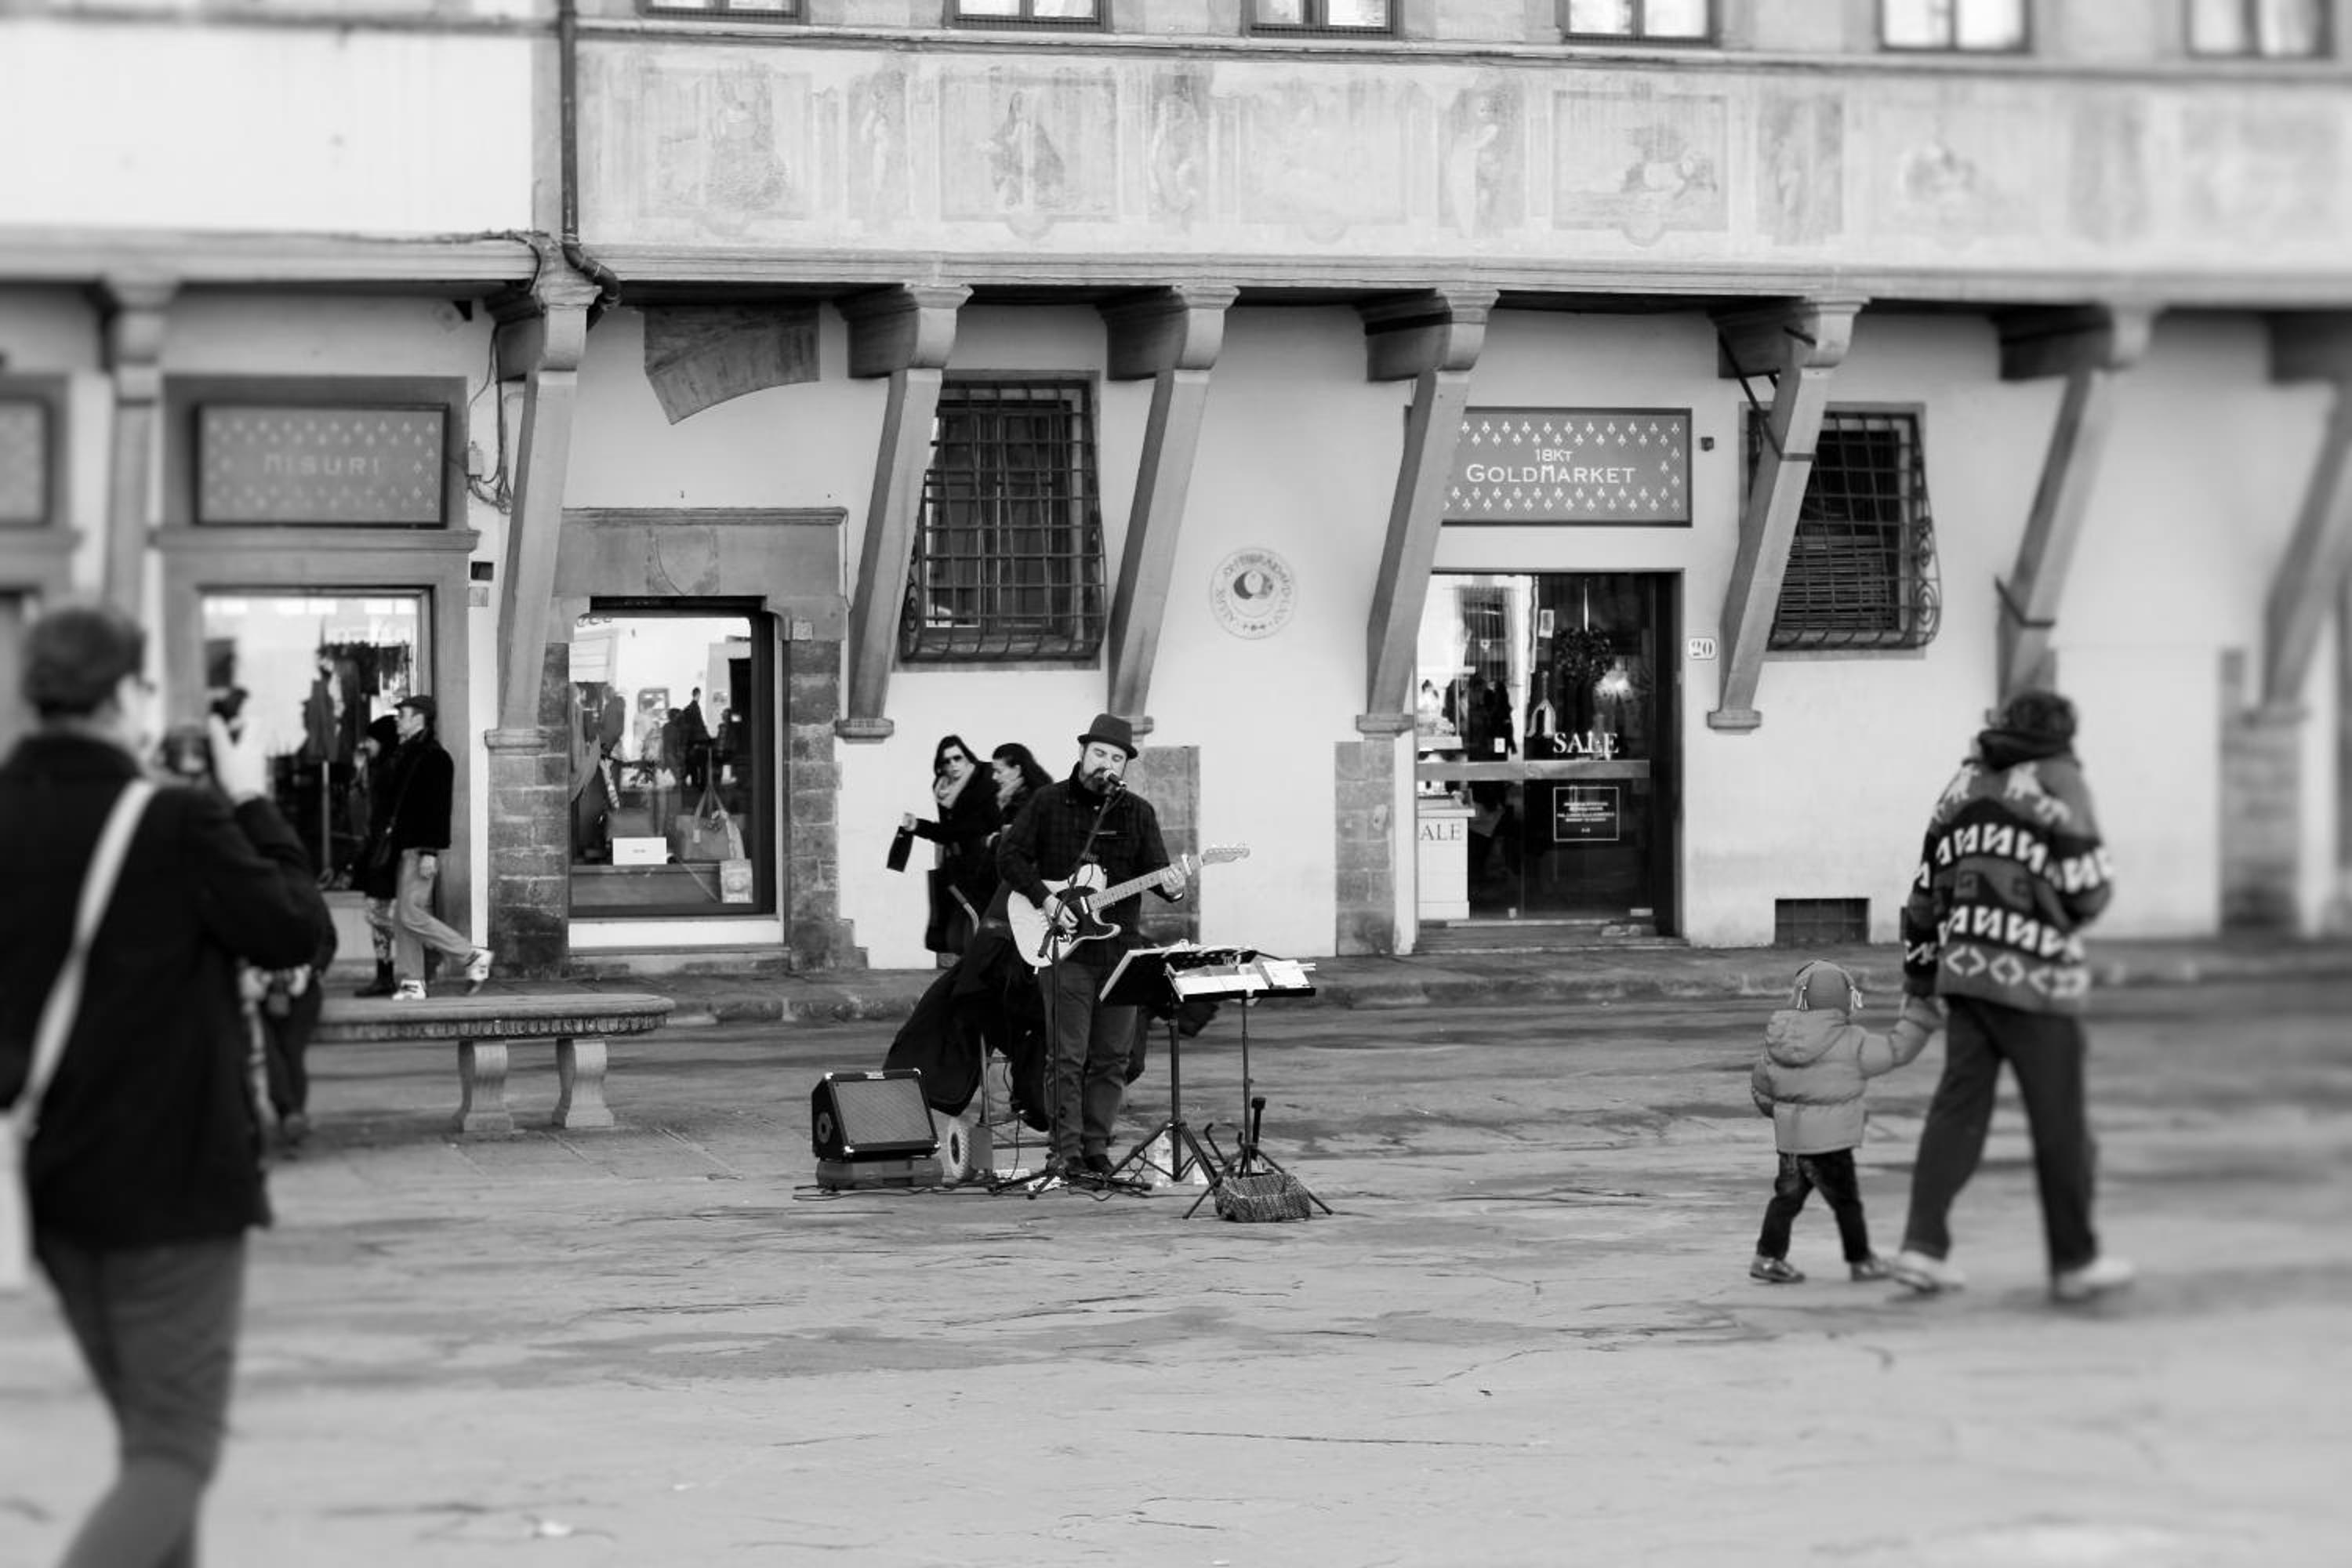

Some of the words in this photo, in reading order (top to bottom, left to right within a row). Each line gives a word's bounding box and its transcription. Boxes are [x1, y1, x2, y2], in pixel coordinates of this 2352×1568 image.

[1466, 463, 1636, 484] GOLDMARKET
[1691, 641, 1713, 656] 20
[1552, 731, 1619, 753] SALE
[1419, 823, 1462, 841] ALE
